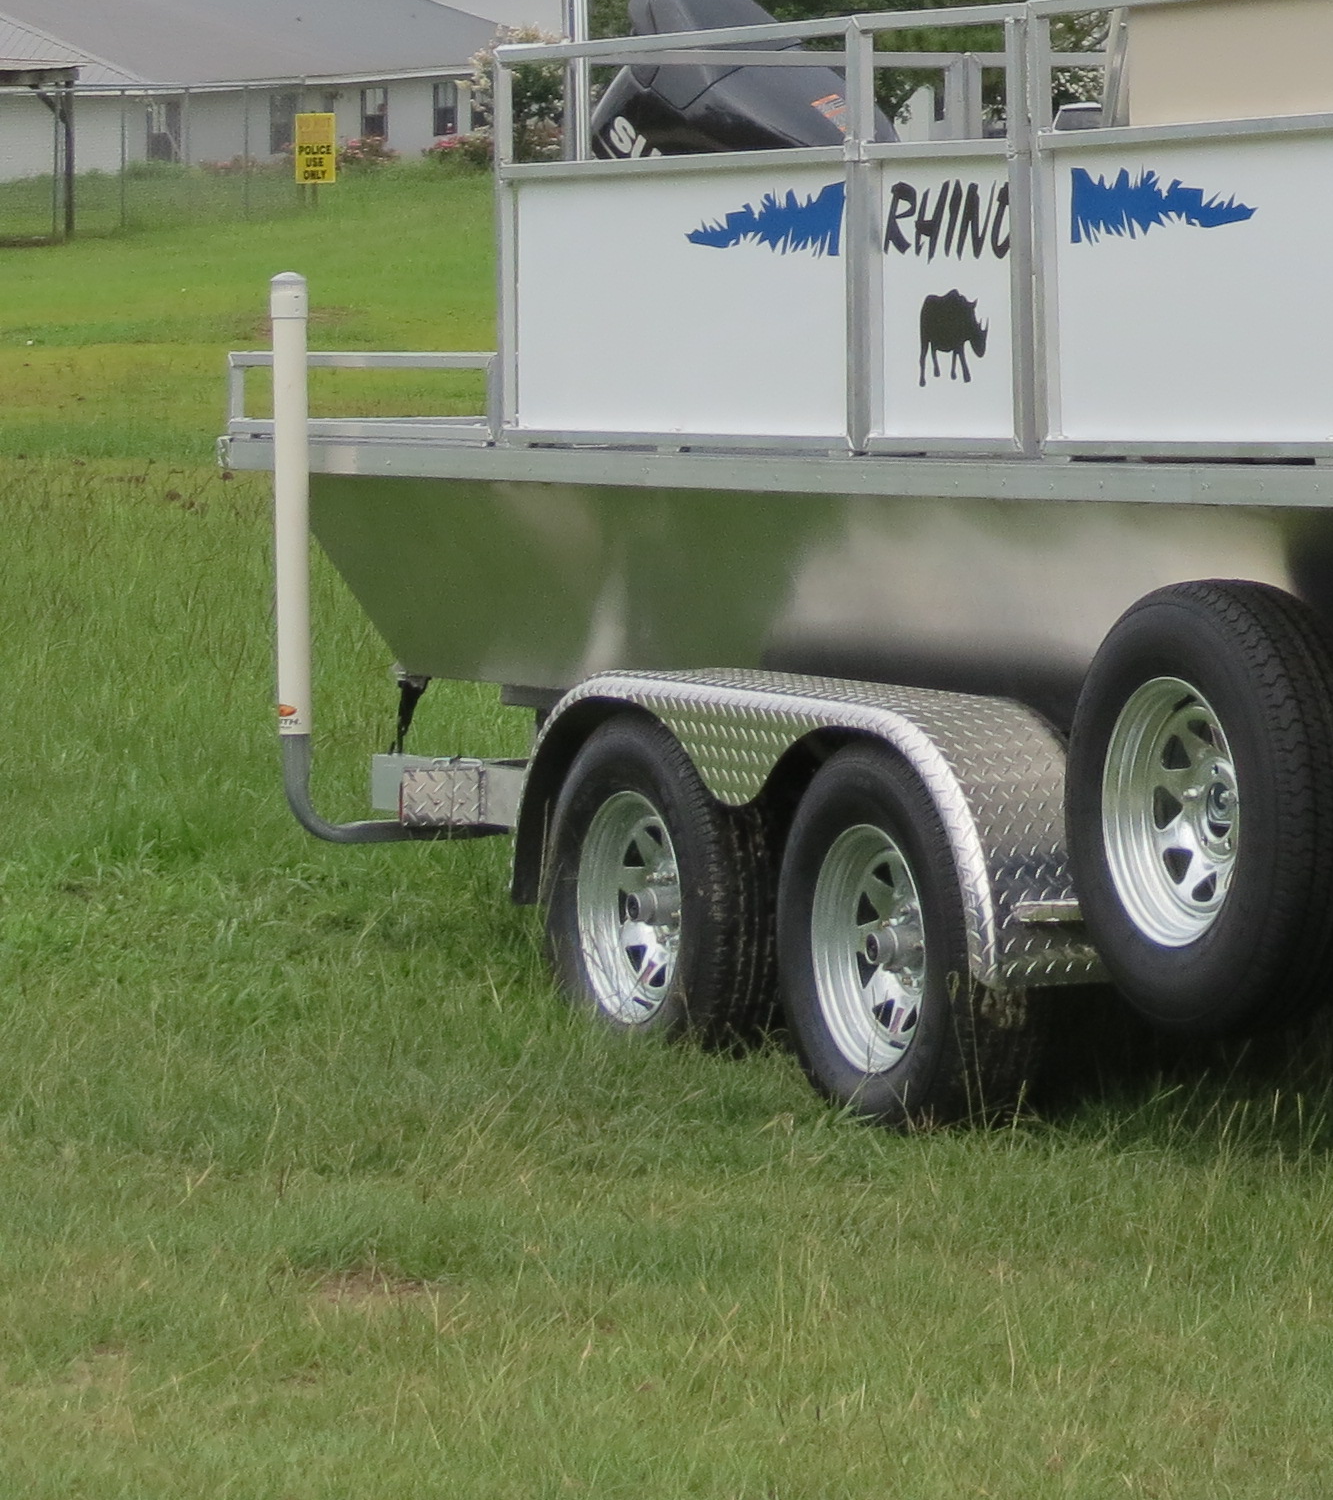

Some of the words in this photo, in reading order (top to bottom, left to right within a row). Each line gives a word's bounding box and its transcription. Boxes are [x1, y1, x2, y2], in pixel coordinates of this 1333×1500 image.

[298, 145, 332, 156] POLICE
[306, 156, 324, 168] USE
[303, 169, 328, 180] ONLY
[884, 179, 1010, 264] RHINO
